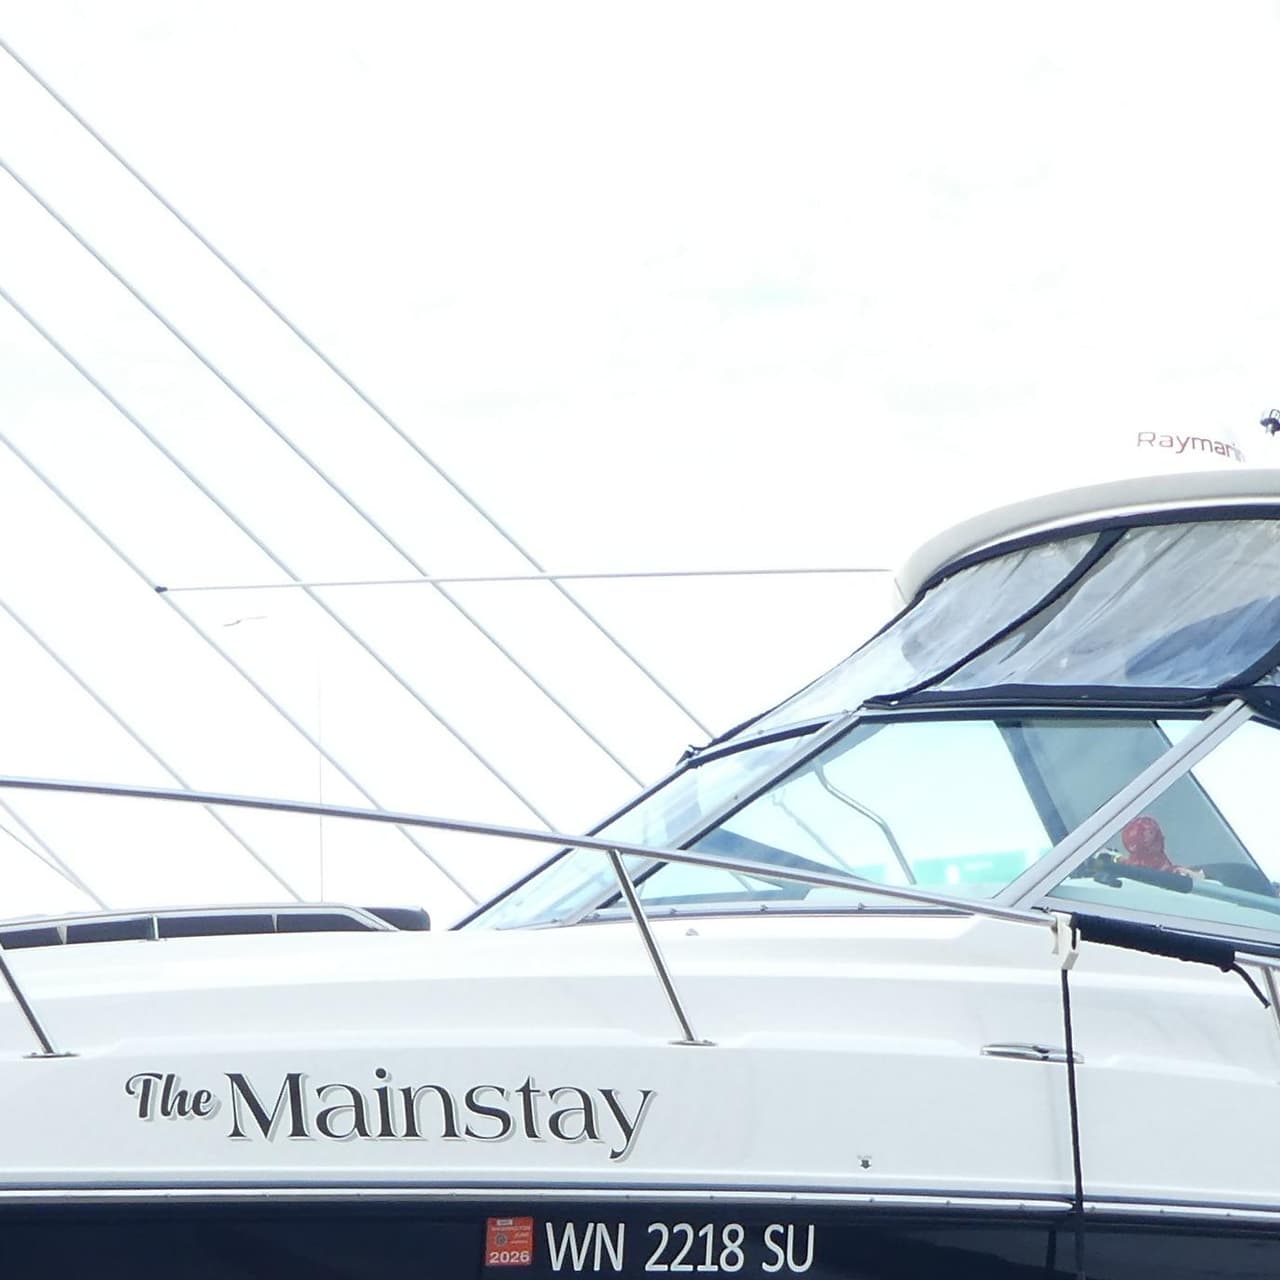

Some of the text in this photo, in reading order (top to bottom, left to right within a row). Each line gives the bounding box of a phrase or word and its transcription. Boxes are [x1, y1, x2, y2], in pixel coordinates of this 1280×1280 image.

[125, 1068, 654, 1161] The Mainstay
[489, 1250, 530, 1264] 2026
[545, 1221, 816, 1274] WN 2218 SU
